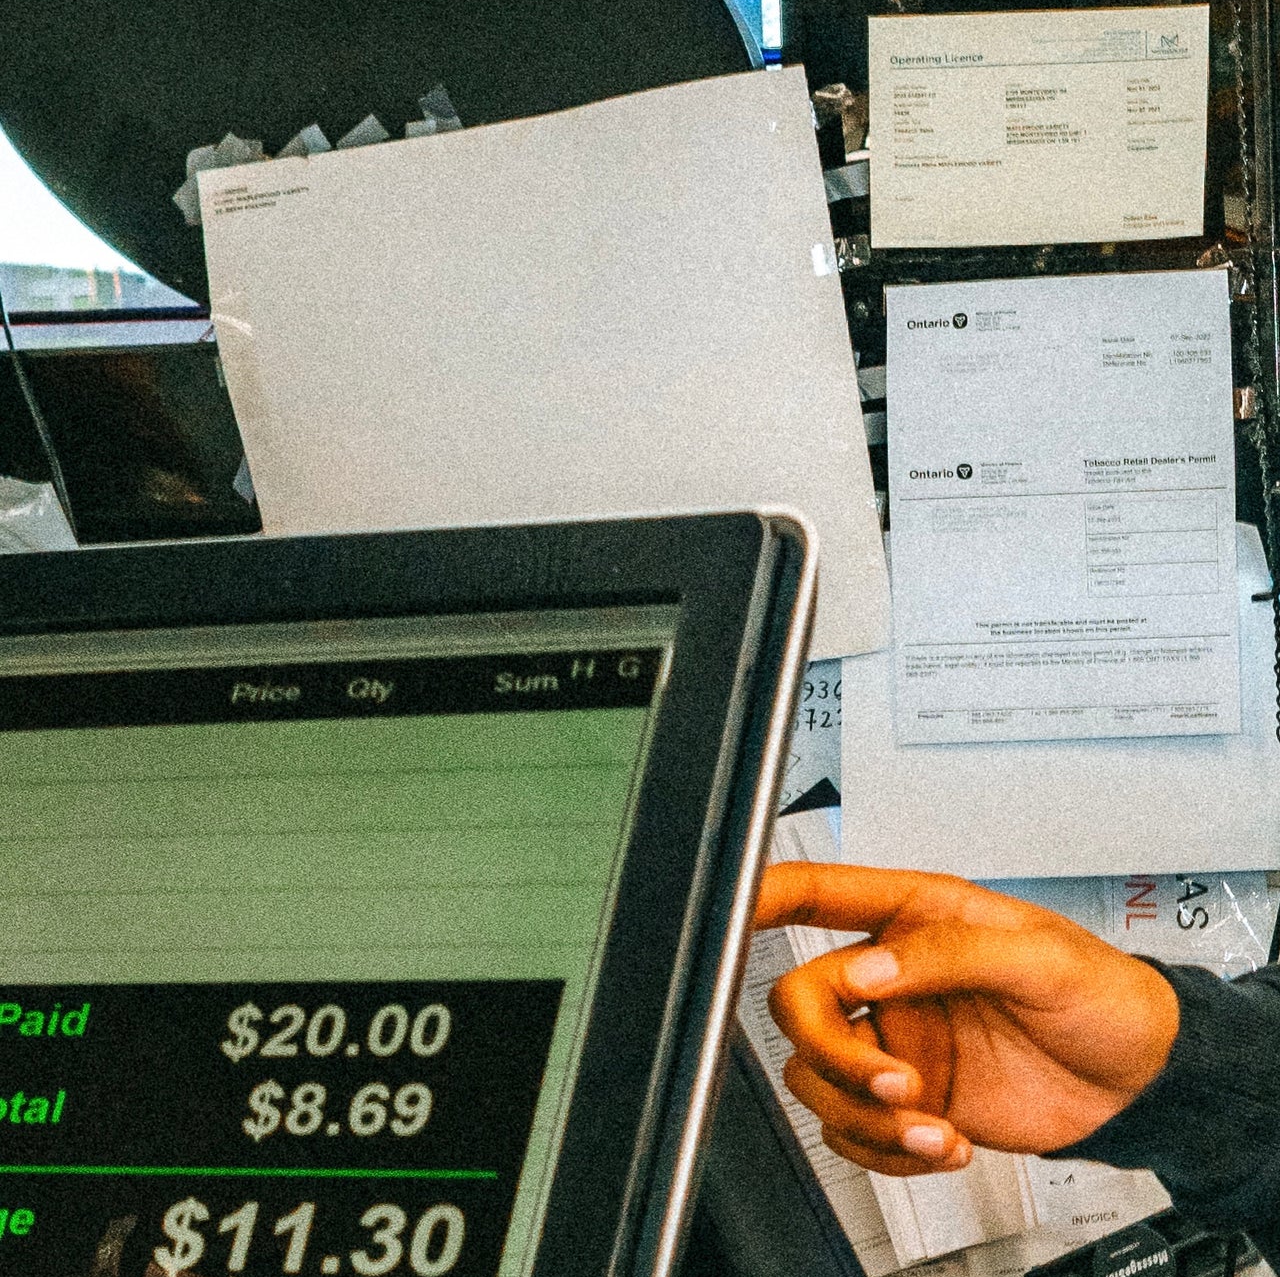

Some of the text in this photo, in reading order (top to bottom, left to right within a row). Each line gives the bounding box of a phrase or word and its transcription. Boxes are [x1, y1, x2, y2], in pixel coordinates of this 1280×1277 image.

[890, 52, 984, 67] Operating Licence
[906, 317, 950, 331] Ontario
[1083, 458, 1121, 468] Tobacco
[1123, 457, 1149, 466] Retail
[1187, 454, 1217, 464] Permit
[909, 468, 954, 481] Ontario
[229, 680, 302, 705] Price
[346, 675, 395, 704] Qty
[494, 669, 560, 695] Sum
[220, 1000, 453, 1064] $20.00
[241, 1079, 434, 1143] $8.69
[1071, 1211, 1118, 1226] INVOICE
